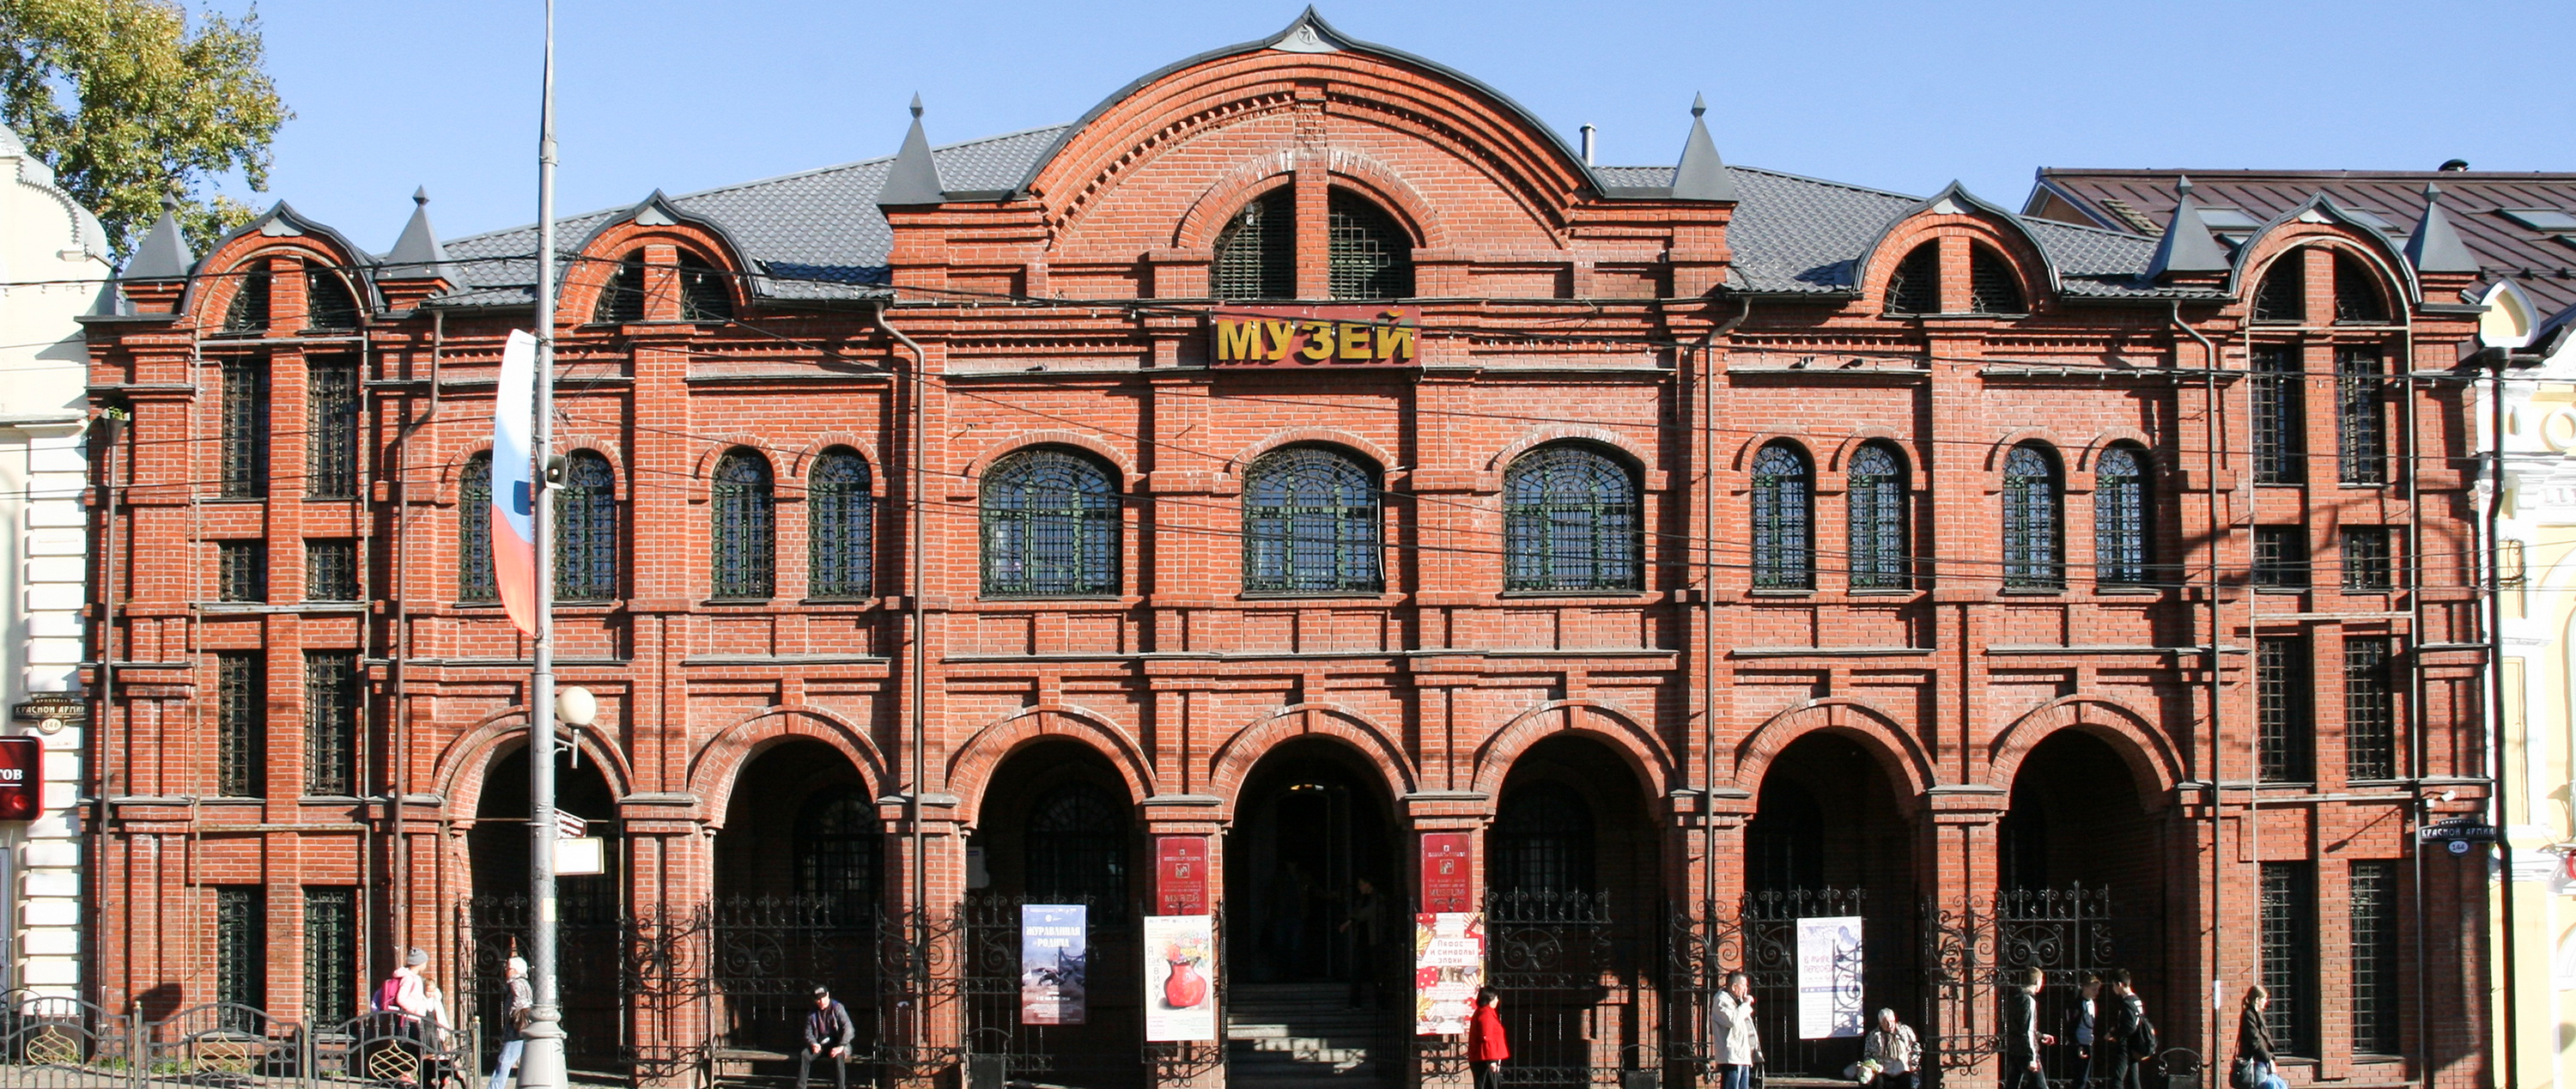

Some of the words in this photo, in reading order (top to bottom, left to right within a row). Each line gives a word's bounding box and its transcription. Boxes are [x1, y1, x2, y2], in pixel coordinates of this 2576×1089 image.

[1218, 308, 1414, 360] МУЗЕЙ
[1165, 891, 1200, 903] МУЗЕЙ
[1147, 946, 1154, 956] Я
